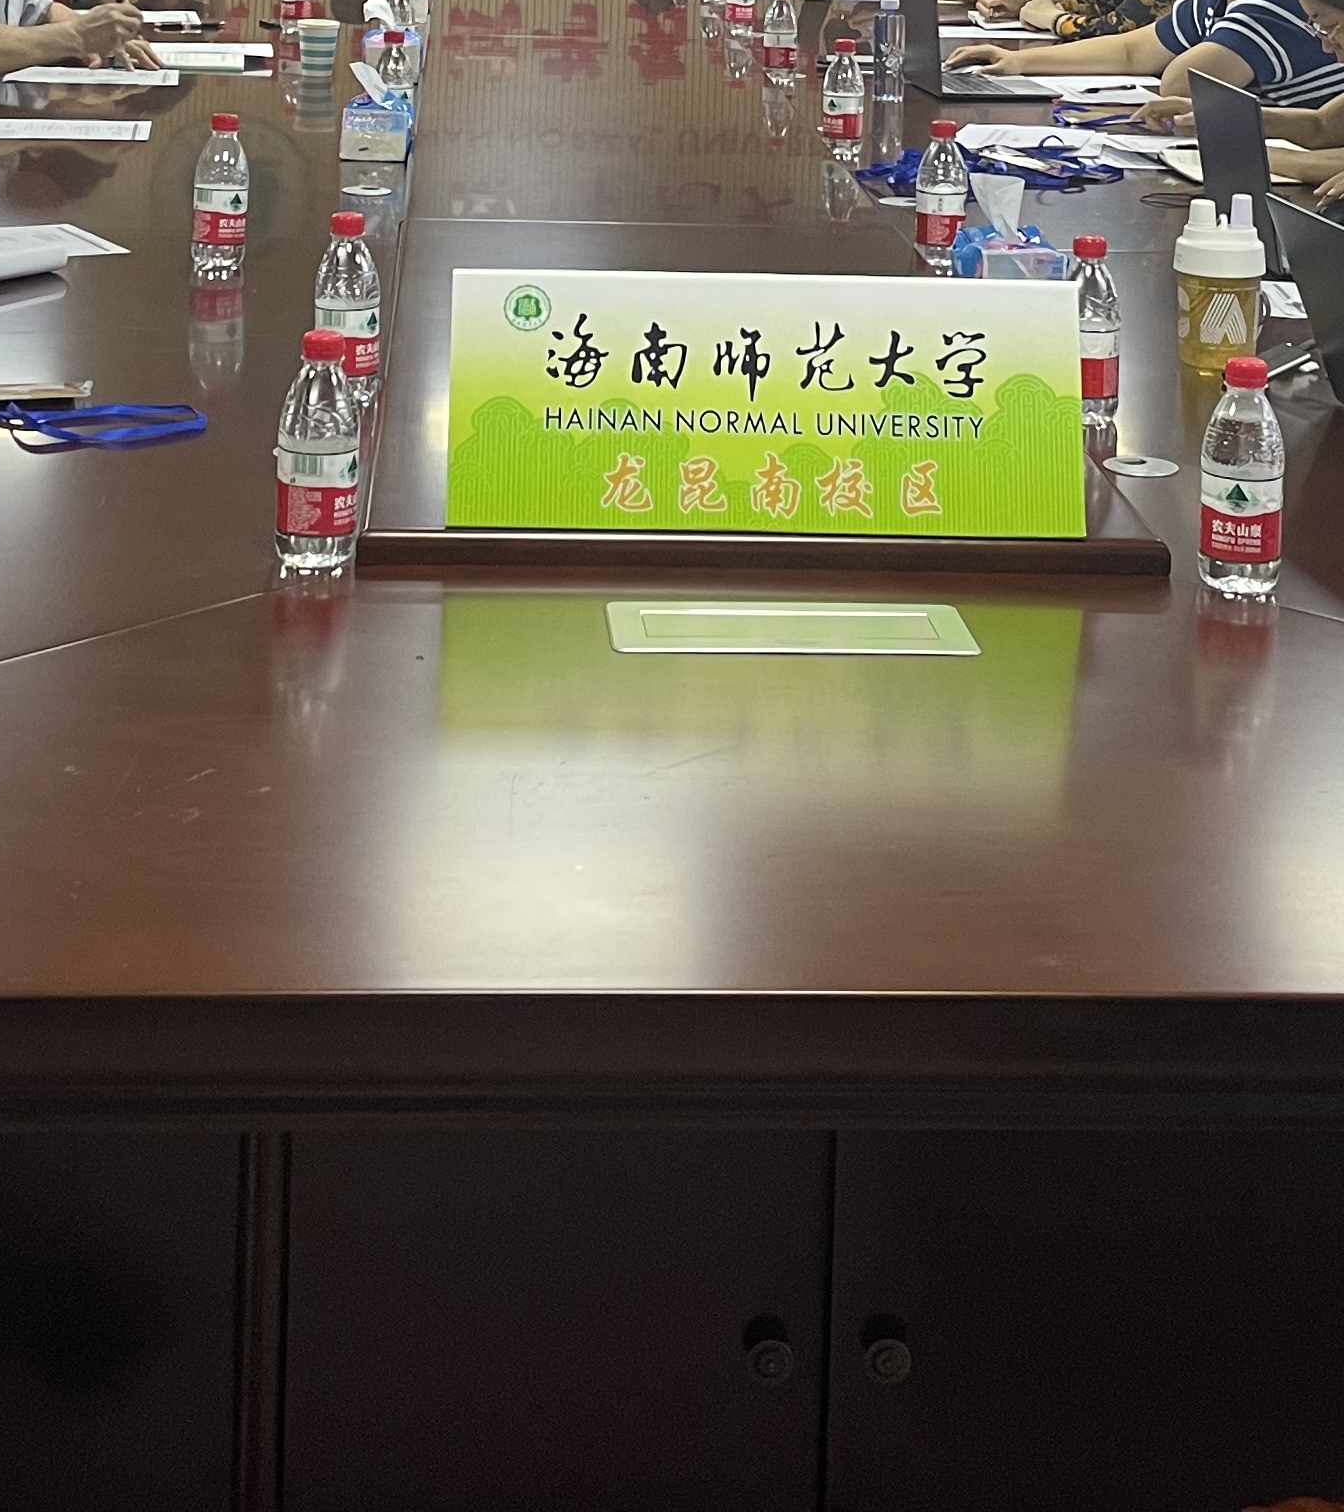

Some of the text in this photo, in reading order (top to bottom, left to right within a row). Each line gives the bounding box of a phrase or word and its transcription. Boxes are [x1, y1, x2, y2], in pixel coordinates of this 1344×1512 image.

[545, 313, 987, 402] 海南师范大学
[545, 406, 985, 441] HAINAN NORMAL UNIVERSITY
[601, 451, 944, 518] 龙昆南校区
[1212, 519, 1263, 538] 农夫山泉
